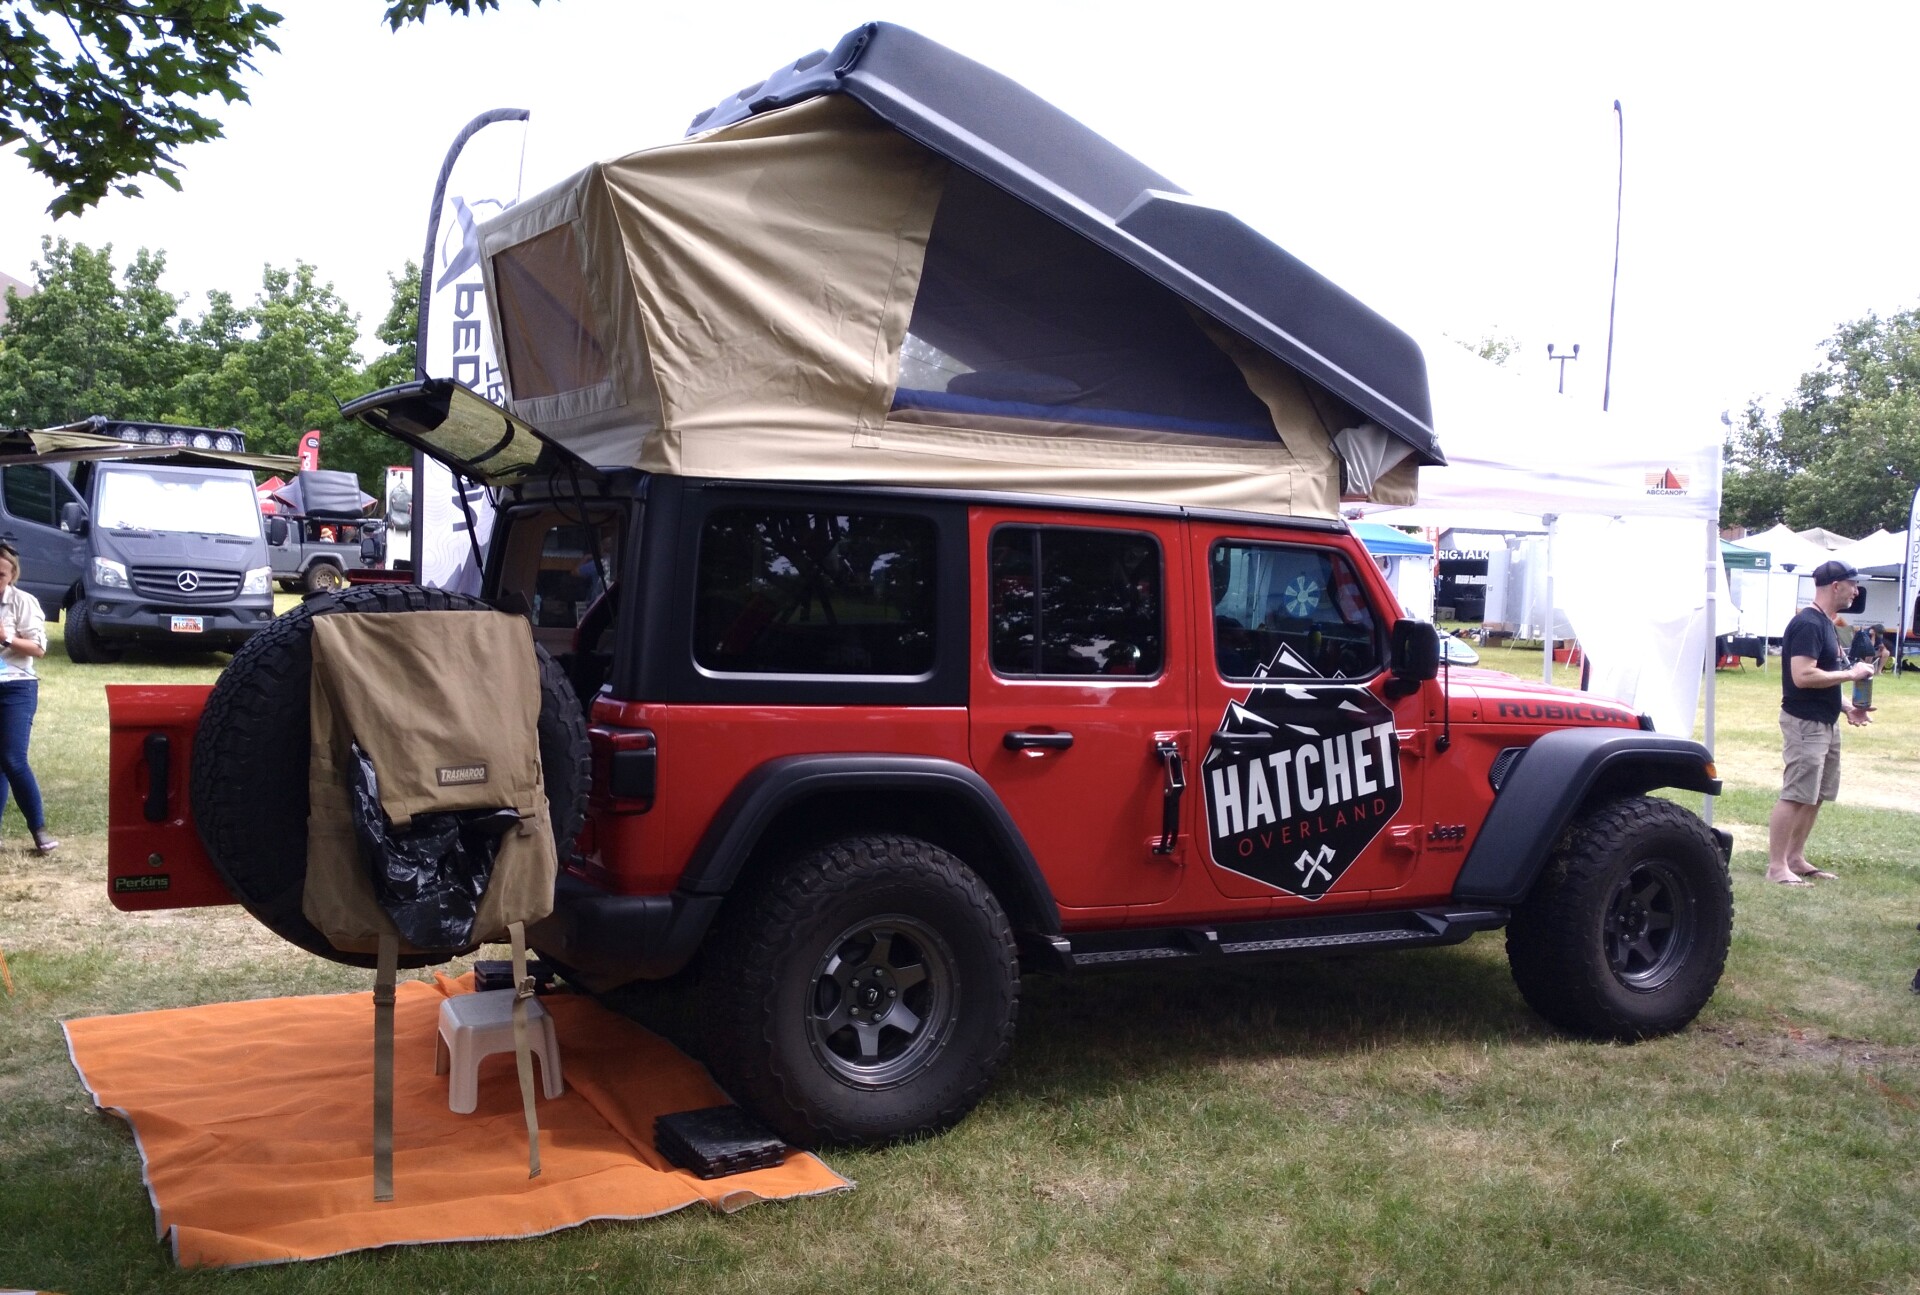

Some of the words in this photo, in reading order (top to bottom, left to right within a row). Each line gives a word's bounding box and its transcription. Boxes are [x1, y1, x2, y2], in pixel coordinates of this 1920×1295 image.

[1909, 536, 1920, 588] PATROL
[1498, 702, 1629, 723] RUBICON
[440, 767, 485, 783] TRASHAROO
[1211, 720, 1395, 839] HATCHET
[1238, 798, 1386, 857] OVERLAND
[1427, 821, 1467, 844] Jeep
[115, 875, 169, 892] Perkins
